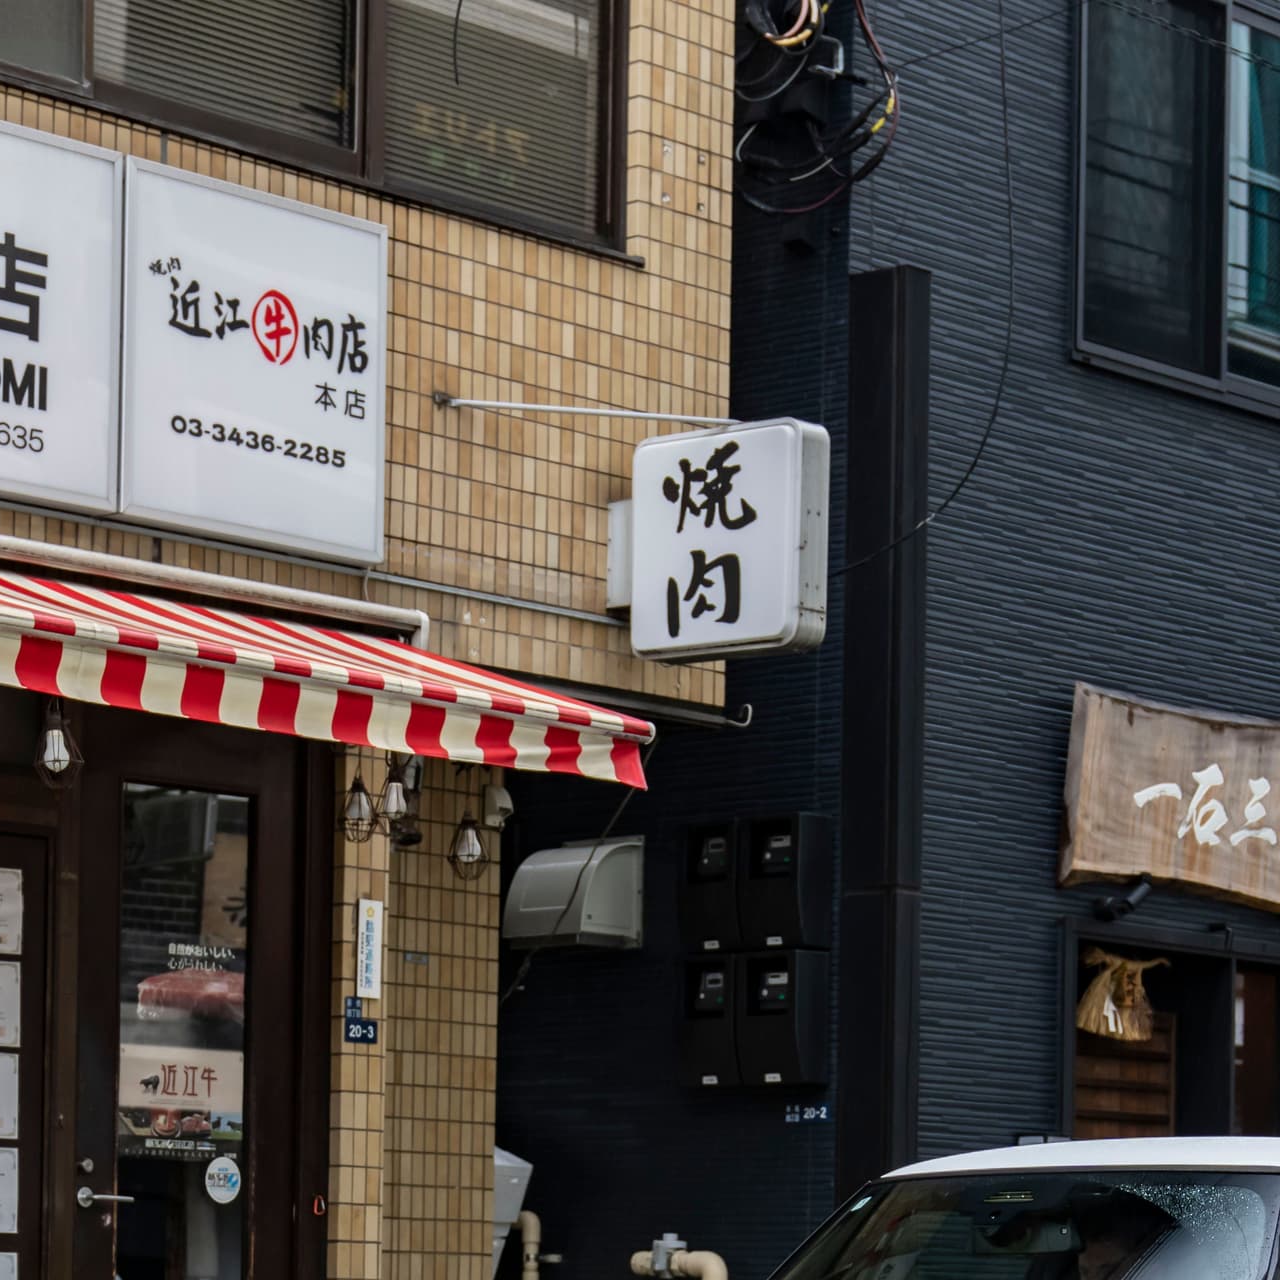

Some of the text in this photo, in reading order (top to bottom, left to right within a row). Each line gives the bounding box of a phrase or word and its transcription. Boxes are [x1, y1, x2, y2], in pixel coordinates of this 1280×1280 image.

[149, 256, 182, 276] 焼肉
[168, 274, 369, 375] 近江牛肉店
[314, 382, 367, 420] 本店
[170, 415, 346, 468] 03-3436-2285
[662, 440, 758, 638] 焼肉
[349, 1024, 374, 1039] 20-3
[161, 1064, 218, 1098] 近江牛
[803, 1106, 828, 1119] 20-2
